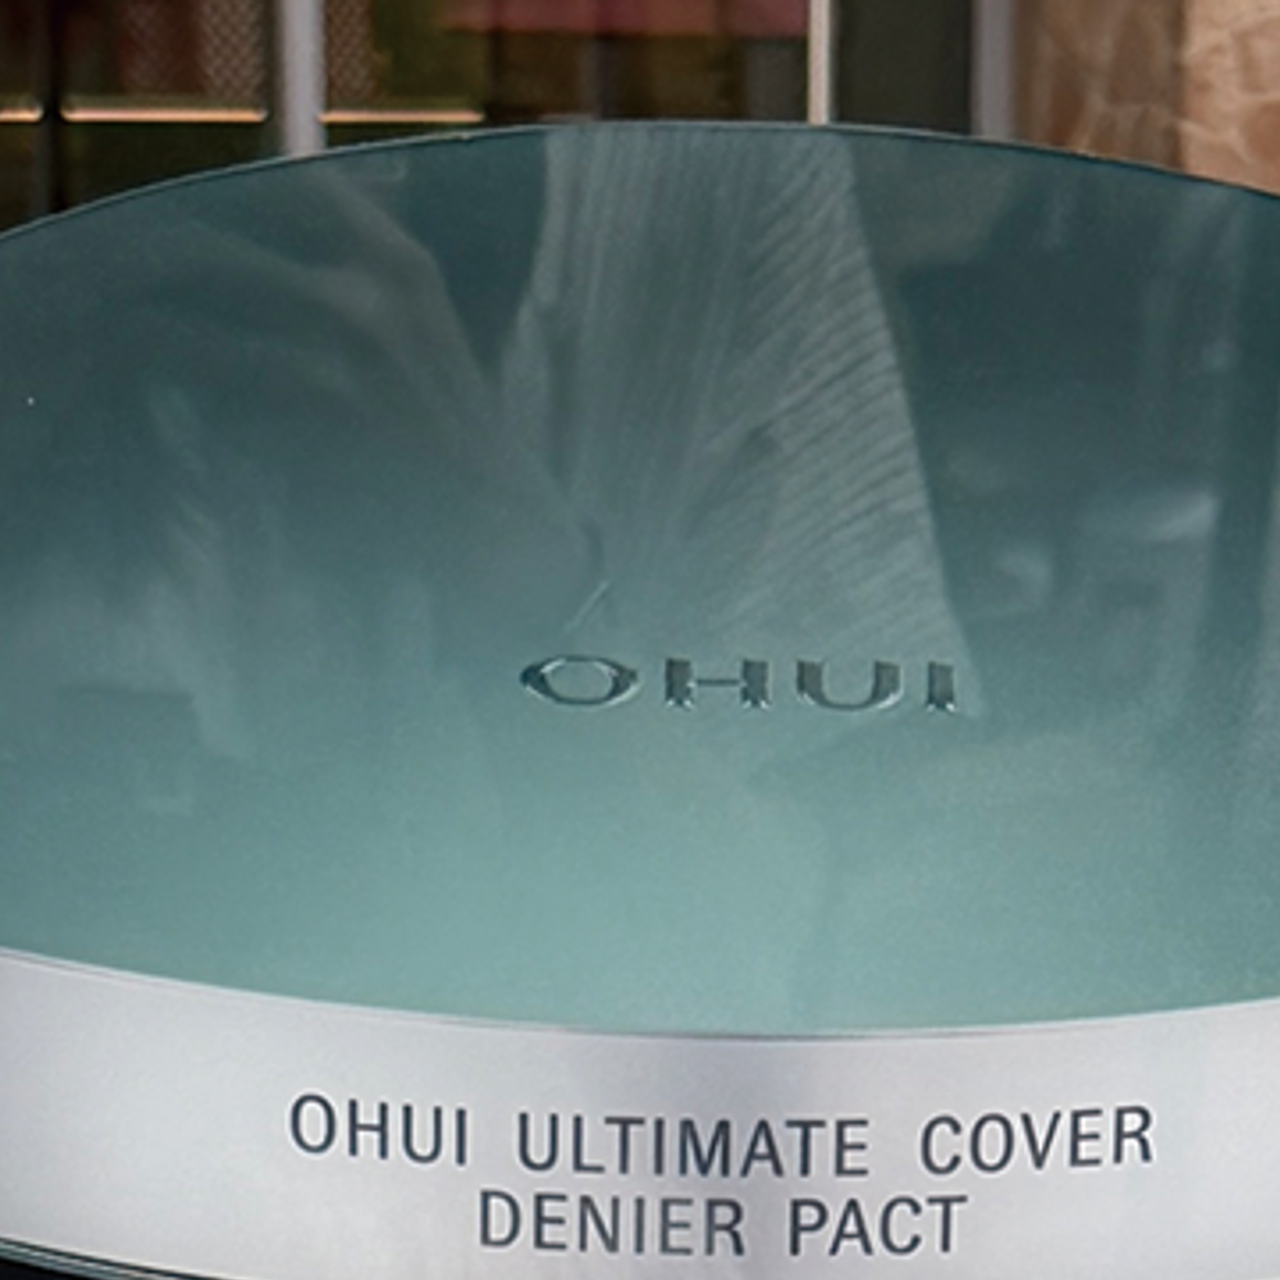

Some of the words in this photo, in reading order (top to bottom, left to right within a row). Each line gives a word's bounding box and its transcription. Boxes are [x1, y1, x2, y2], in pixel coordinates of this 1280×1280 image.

[521, 654, 956, 711] OHUI
[290, 1093, 468, 1166] OHUI
[519, 1112, 869, 1178] ULTIMATE
[921, 1105, 1153, 1176] COVER
[479, 1190, 745, 1256] DENIER
[788, 1194, 969, 1256] PACT
